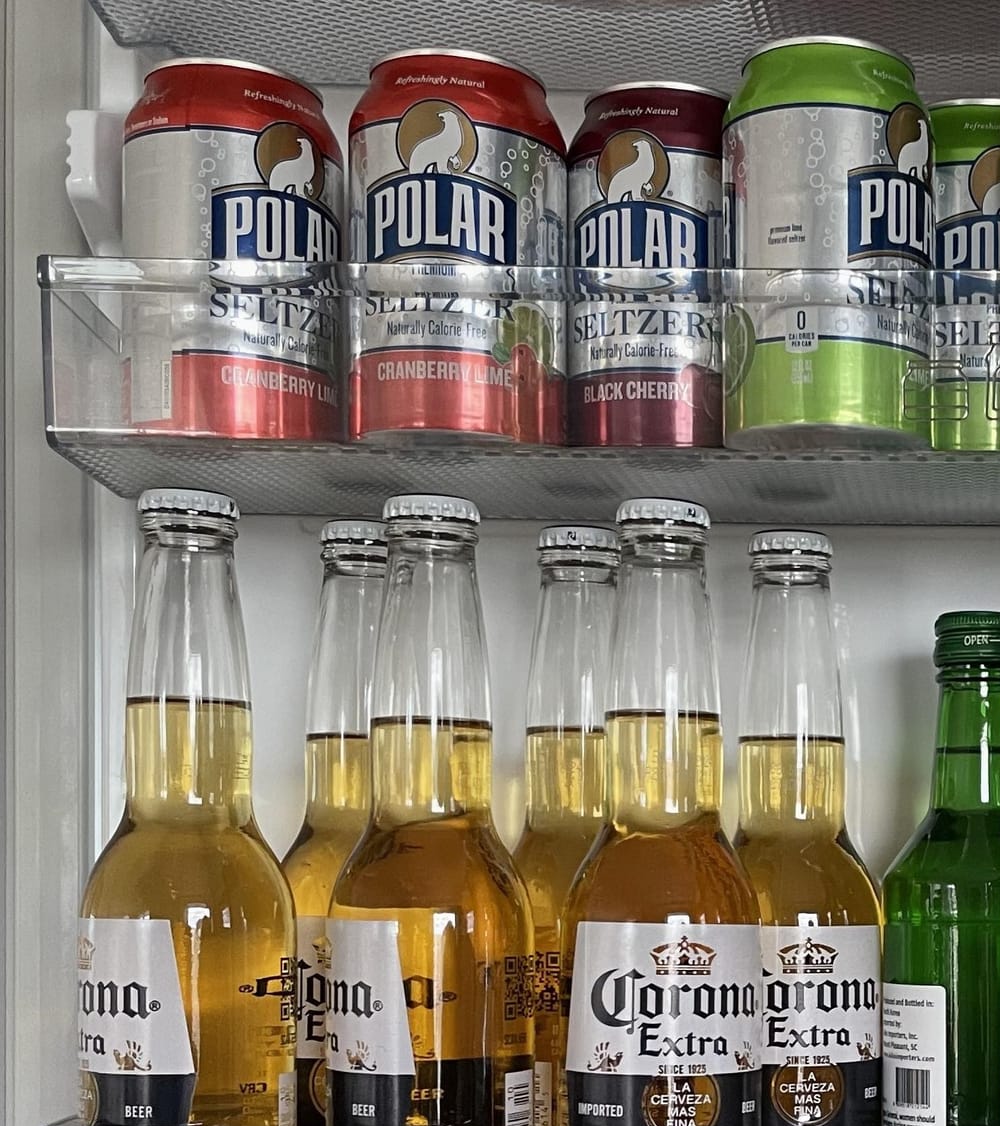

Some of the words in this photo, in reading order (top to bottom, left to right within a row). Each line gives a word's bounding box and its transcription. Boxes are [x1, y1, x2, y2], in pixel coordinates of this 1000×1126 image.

[450, 76, 486, 89] Natural
[645, 107, 679, 118] Natural
[374, 179, 506, 265] POLAR
[580, 206, 697, 268] POLAR
[365, 294, 515, 321] SELTZER
[573, 308, 712, 344] SELTZER
[797, 309, 807, 330] 0
[387, 320, 426, 339] Naturally
[788, 332, 815, 342] CALORIES
[589, 344, 623, 362] Naturally
[791, 341, 801, 349] PER
[802, 341, 813, 349] CAN
[221, 365, 316, 399] CRANBERRY
[377, 361, 474, 383] CRANBERRY
[474, 364, 514, 390] LIME
[584, 381, 623, 404] BLACK
[625, 378, 691, 402] CHERRY
[964, 634, 991, 647] OPEN
[591, 968, 757, 1036] Corona
[764, 979, 877, 1016] orona
[639, 1021, 730, 1059] Extra
[767, 1015, 852, 1050] Extra
[786, 1054, 811, 1066] SINCE
[812, 1054, 832, 1066] 1925
[658, 1065, 685, 1076] SINCE
[687, 1065, 708, 1076] 1925
[798, 1070, 818, 1083] LA
[672, 1081, 692, 1094] LA
[779, 1083, 836, 1095] CERVEZA
[651, 1094, 712, 1107] CERVEZA
[794, 1094, 823, 1106] MAS
[125, 1104, 153, 1119] BEER
[352, 1103, 376, 1119] BEER
[577, 1102, 624, 1118] IMPORTED
[667, 1106, 698, 1118] MAS
[793, 1105, 822, 1118] FINA
